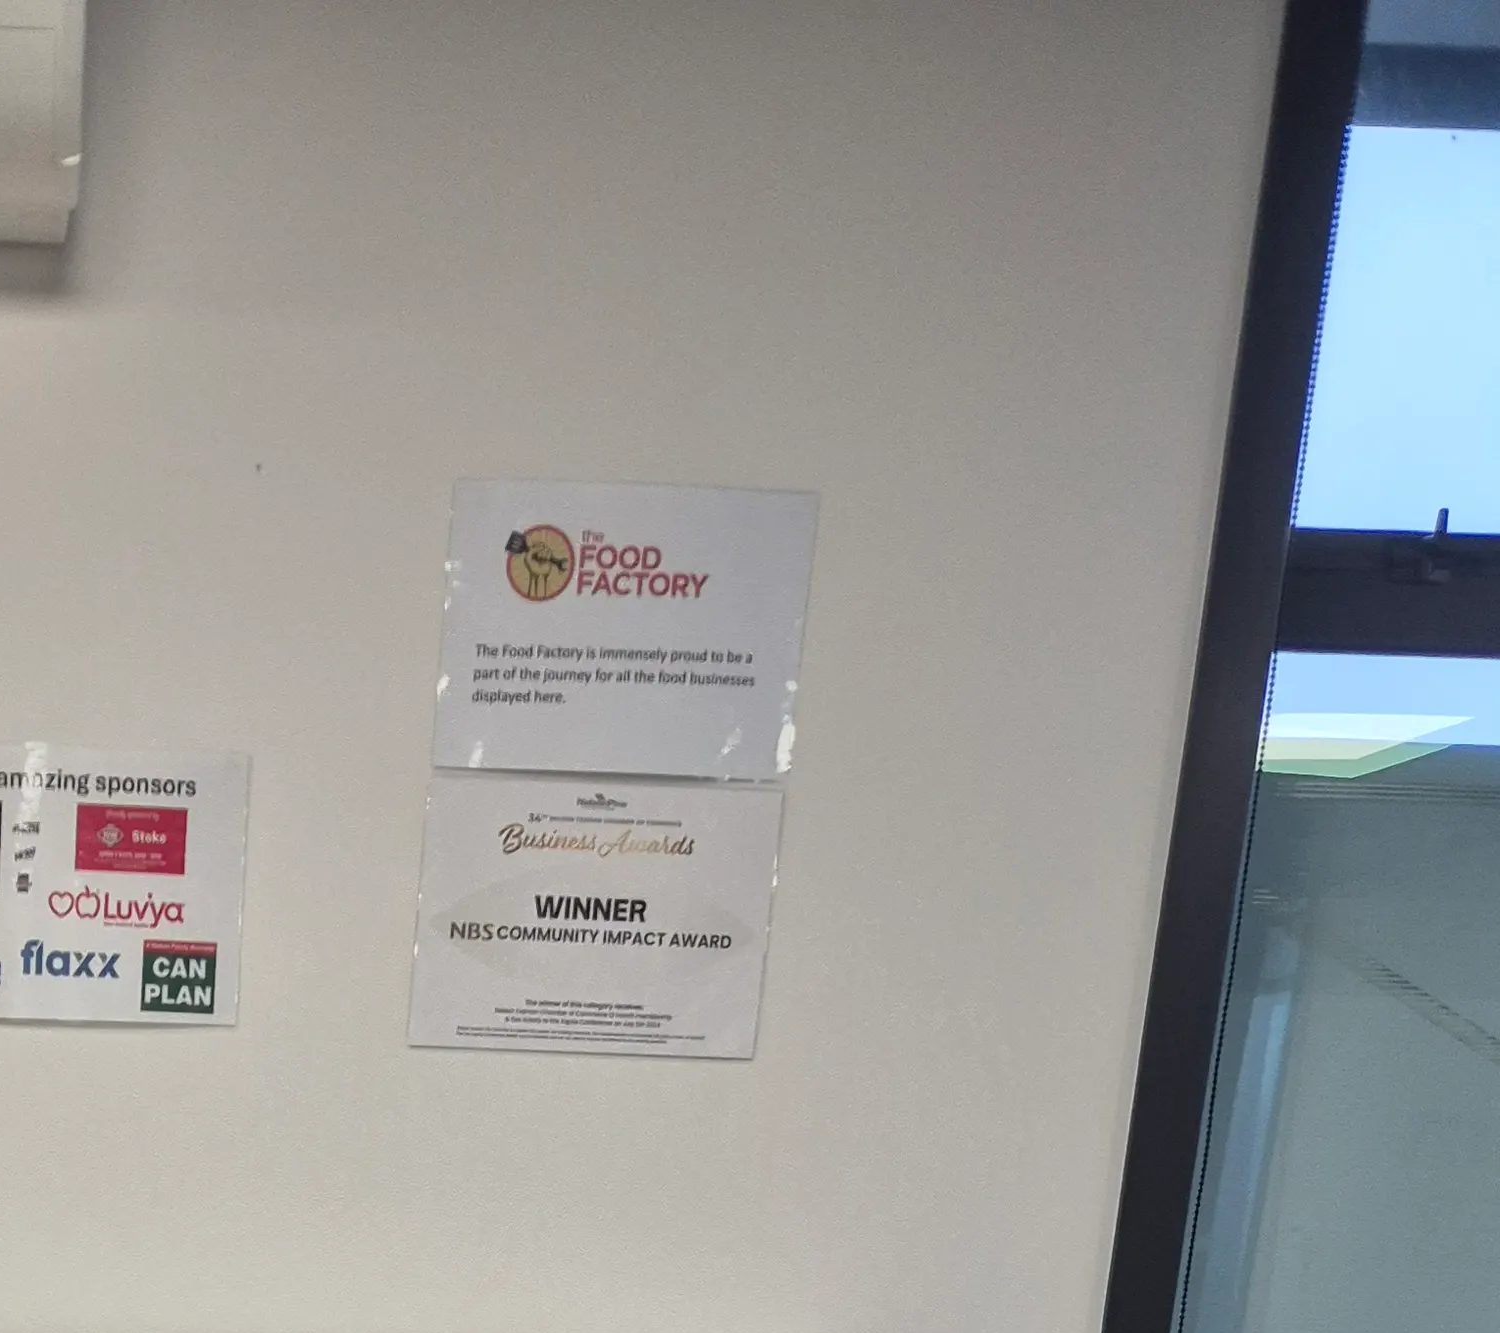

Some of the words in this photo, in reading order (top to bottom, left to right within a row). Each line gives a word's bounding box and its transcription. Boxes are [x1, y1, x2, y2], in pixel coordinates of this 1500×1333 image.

[580, 530, 605, 543] the
[579, 545, 662, 570] FOOD
[576, 571, 710, 599] FACTORY
[476, 643, 498, 659] The
[502, 644, 533, 659] Food
[537, 645, 582, 662] Factory
[586, 646, 596, 660] is
[599, 646, 667, 664] immensely
[670, 650, 707, 664] proud
[711, 650, 724, 663] to
[727, 650, 742, 663] be
[745, 653, 753, 664] a
[473, 667, 500, 683] part
[503, 666, 517, 681] of
[520, 668, 540, 681] the
[542, 668, 592, 685] journey
[595, 668, 613, 683] for
[616, 669, 630, 684] all
[634, 670, 655, 684] the
[658, 670, 687, 685] food
[690, 670, 755, 687] businesses
[471, 688, 530, 706] displayed
[533, 689, 566, 704] here.
[95, 775, 197, 798] sponsors
[499, 823, 597, 855] Business
[599, 828, 696, 858] Awards
[534, 895, 647, 923] WINNER
[449, 921, 495, 941] NBS
[496, 924, 598, 945] COMMUNITY
[602, 928, 667, 947] IMPACT
[668, 931, 732, 950] AWARD
[20, 939, 122, 979] flaxx
[152, 956, 207, 980] CAN
[144, 983, 212, 1007] PLAN
